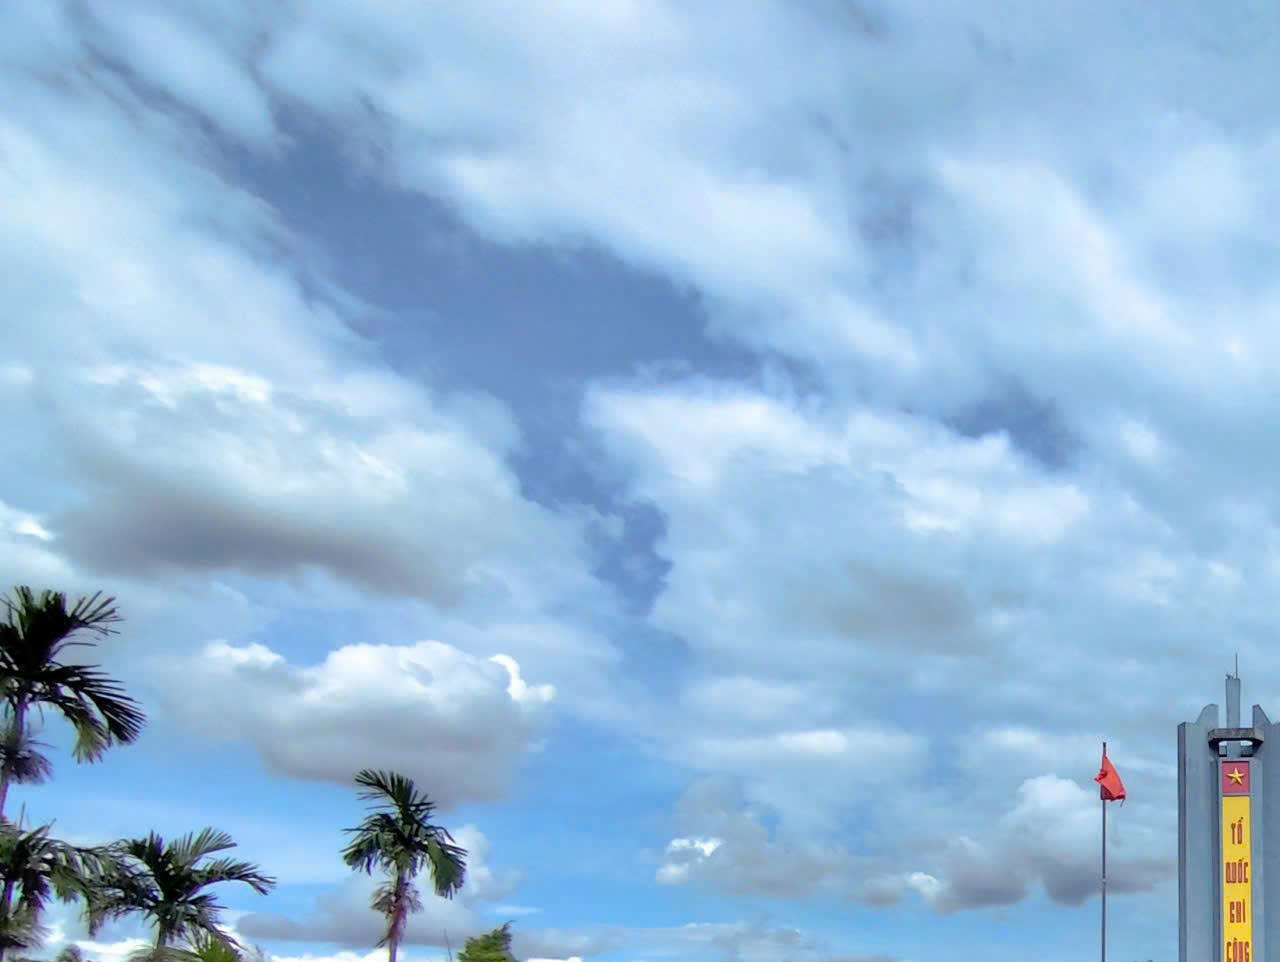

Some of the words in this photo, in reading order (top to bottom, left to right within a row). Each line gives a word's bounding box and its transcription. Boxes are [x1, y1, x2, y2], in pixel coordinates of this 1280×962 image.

[1225, 857, 1248, 883] QUỐC
[1229, 899, 1246, 923] GHI
[1226, 937, 1250, 962] CÔNG
